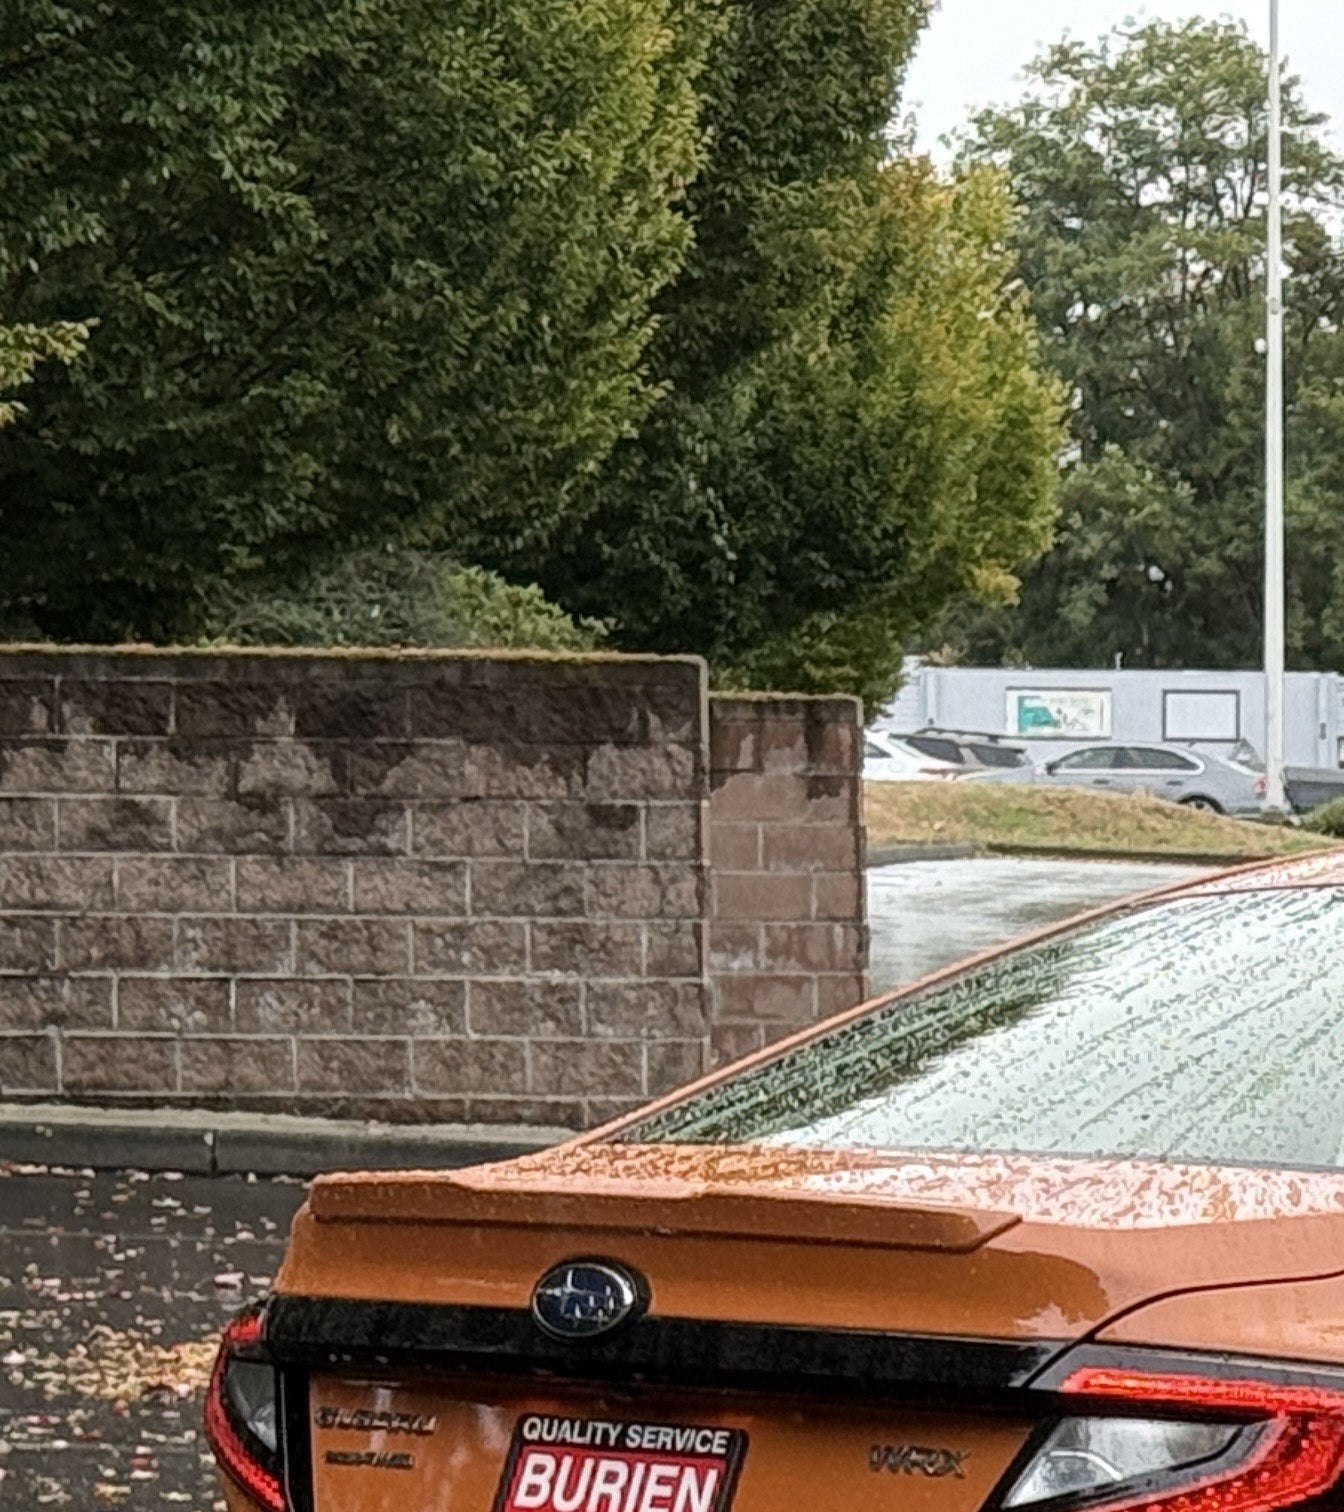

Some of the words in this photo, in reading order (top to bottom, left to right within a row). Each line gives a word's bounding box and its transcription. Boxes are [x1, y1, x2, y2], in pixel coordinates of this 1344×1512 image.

[523, 1416, 622, 1447] QUALITY
[625, 1424, 731, 1455] SERVICE
[868, 1444, 971, 1479] WRX
